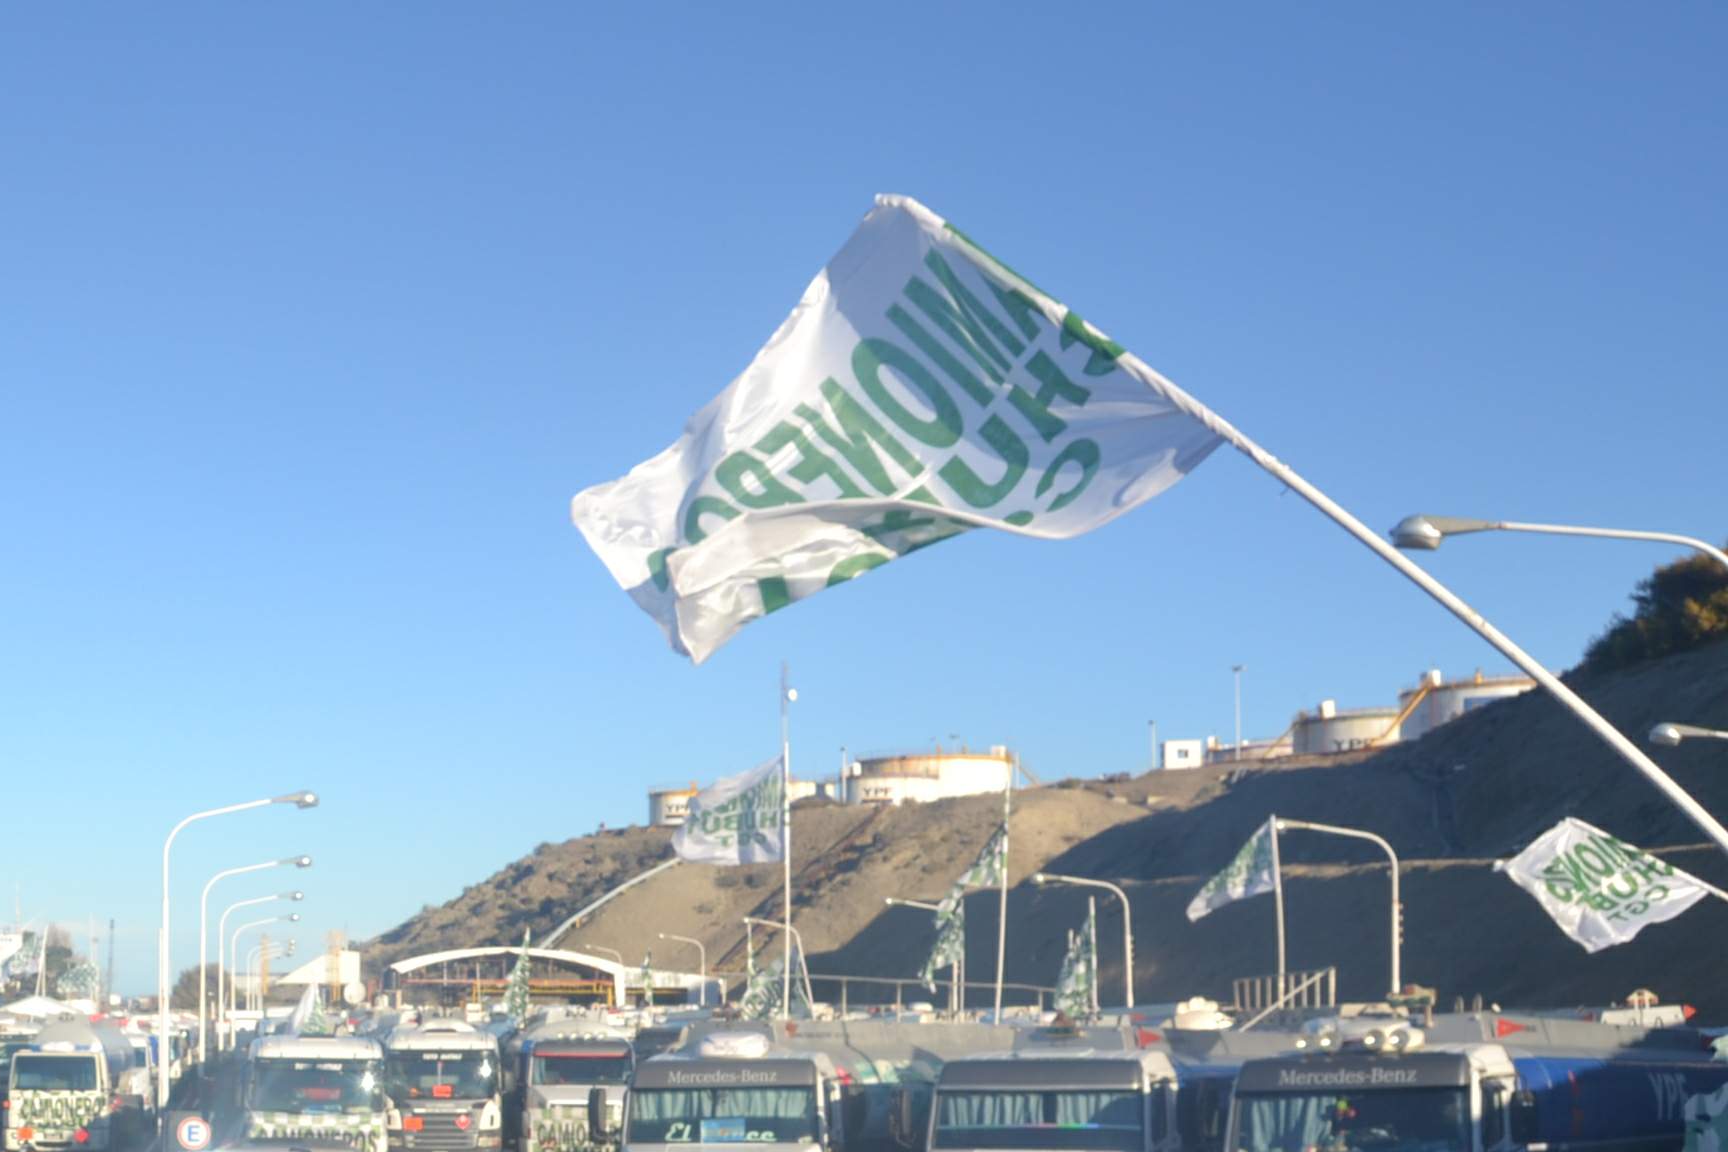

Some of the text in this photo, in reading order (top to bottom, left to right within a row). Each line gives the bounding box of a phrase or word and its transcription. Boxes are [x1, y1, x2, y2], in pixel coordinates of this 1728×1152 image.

[862, 787, 893, 797] YPF
[668, 1069, 777, 1084] Mercedes-Benz
[1278, 1068, 1417, 1086] Mercedes-Benz
[187, 1124, 200, 1142] E
